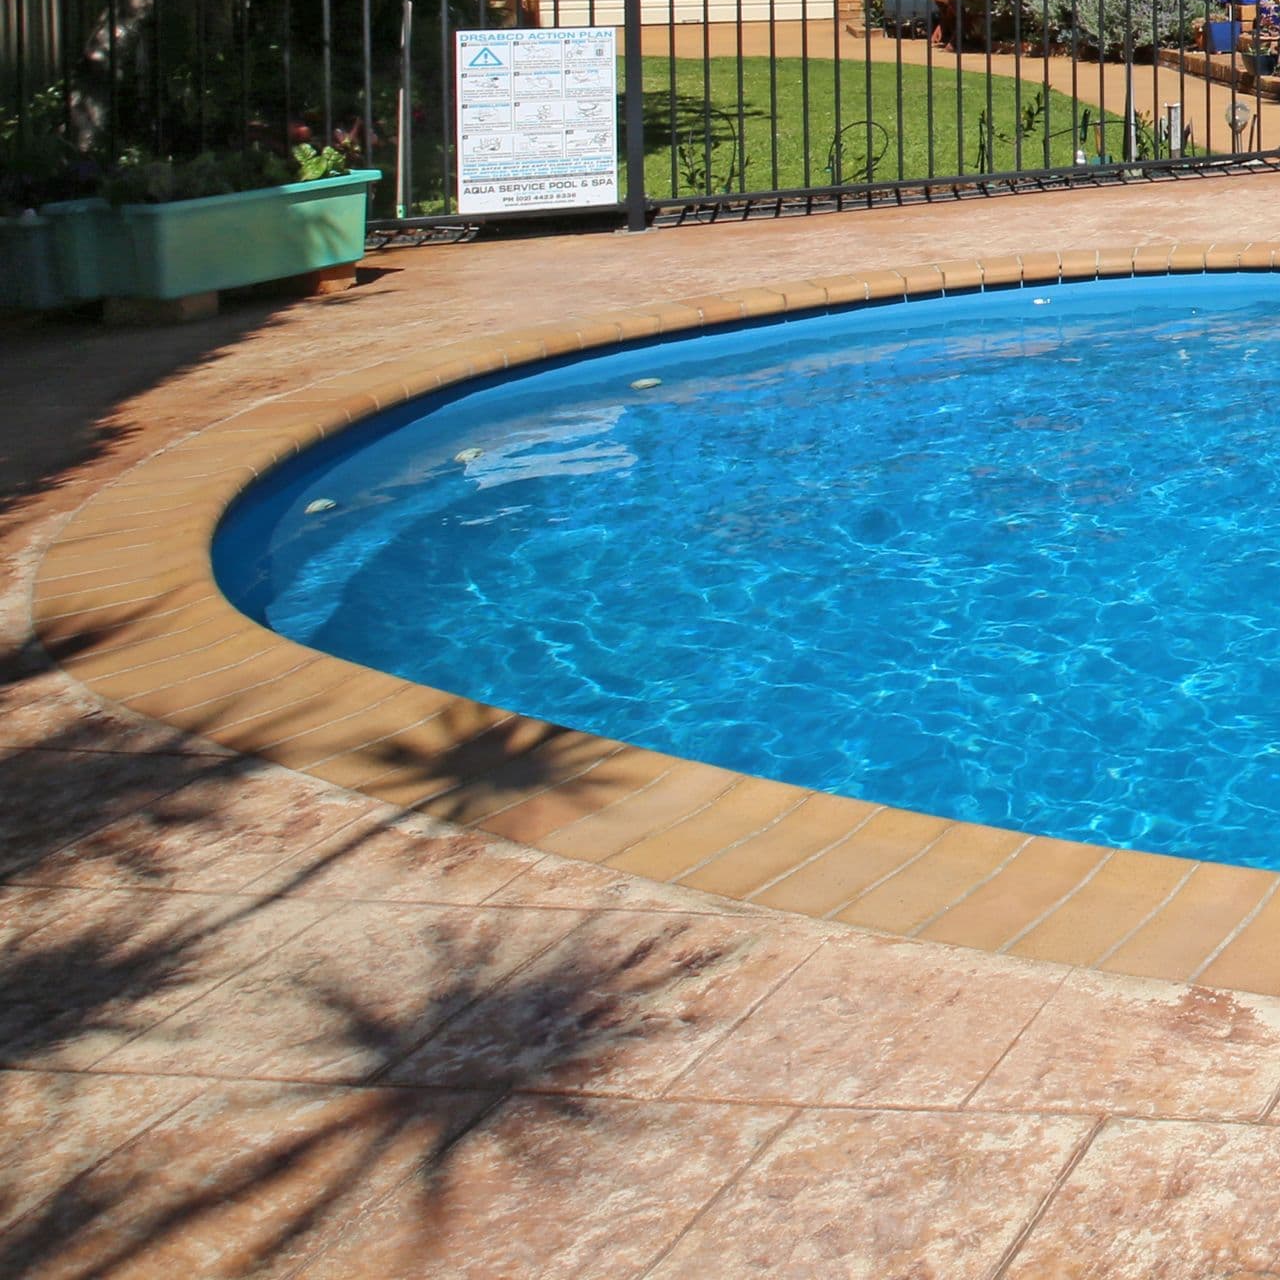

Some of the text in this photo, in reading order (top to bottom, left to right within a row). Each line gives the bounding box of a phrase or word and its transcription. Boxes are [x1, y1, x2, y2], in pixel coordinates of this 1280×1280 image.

[460, 33, 524, 42] DRSABCD
[529, 32, 576, 40] ACTION
[580, 31, 613, 39] PLAN
[464, 186, 495, 195] AQUA
[499, 183, 545, 193] SERVICE
[550, 181, 577, 190] POOL
[581, 179, 588, 188] &
[592, 178, 613, 187] SPA
